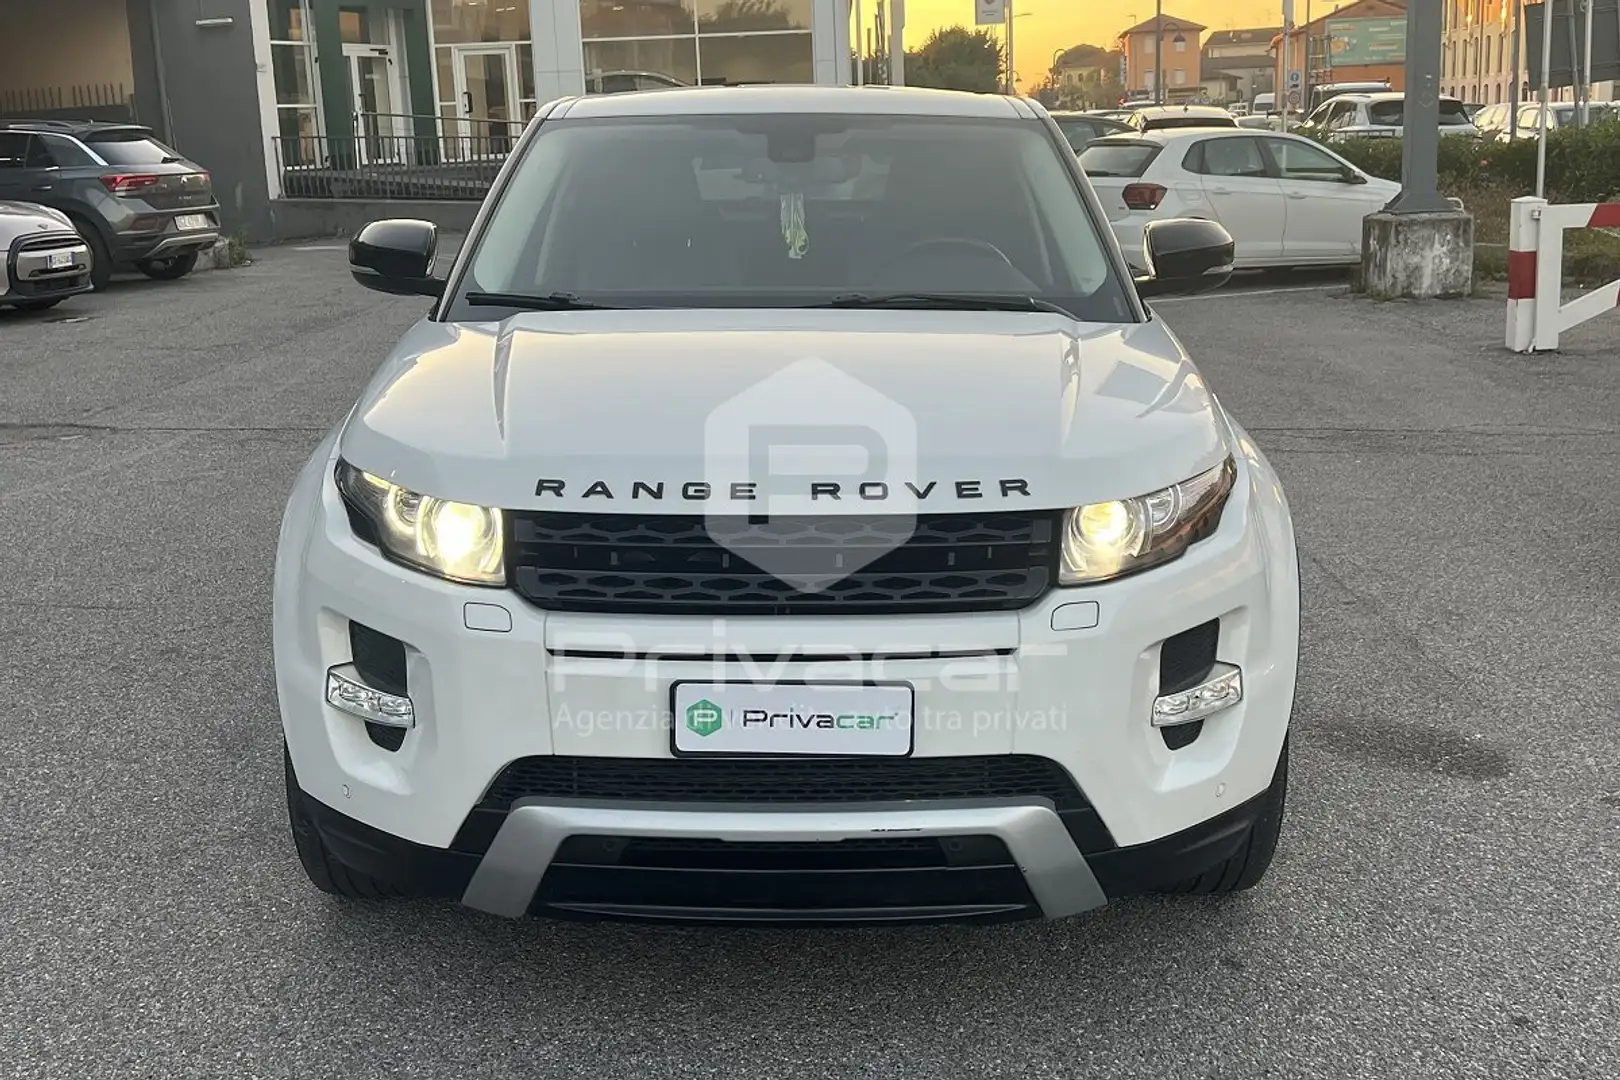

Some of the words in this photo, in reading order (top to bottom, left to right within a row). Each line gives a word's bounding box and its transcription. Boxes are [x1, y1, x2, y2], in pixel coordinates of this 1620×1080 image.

[534, 478, 757, 501] RANGE
[811, 478, 1032, 501] ROVER
[742, 706, 895, 729] Privacar
